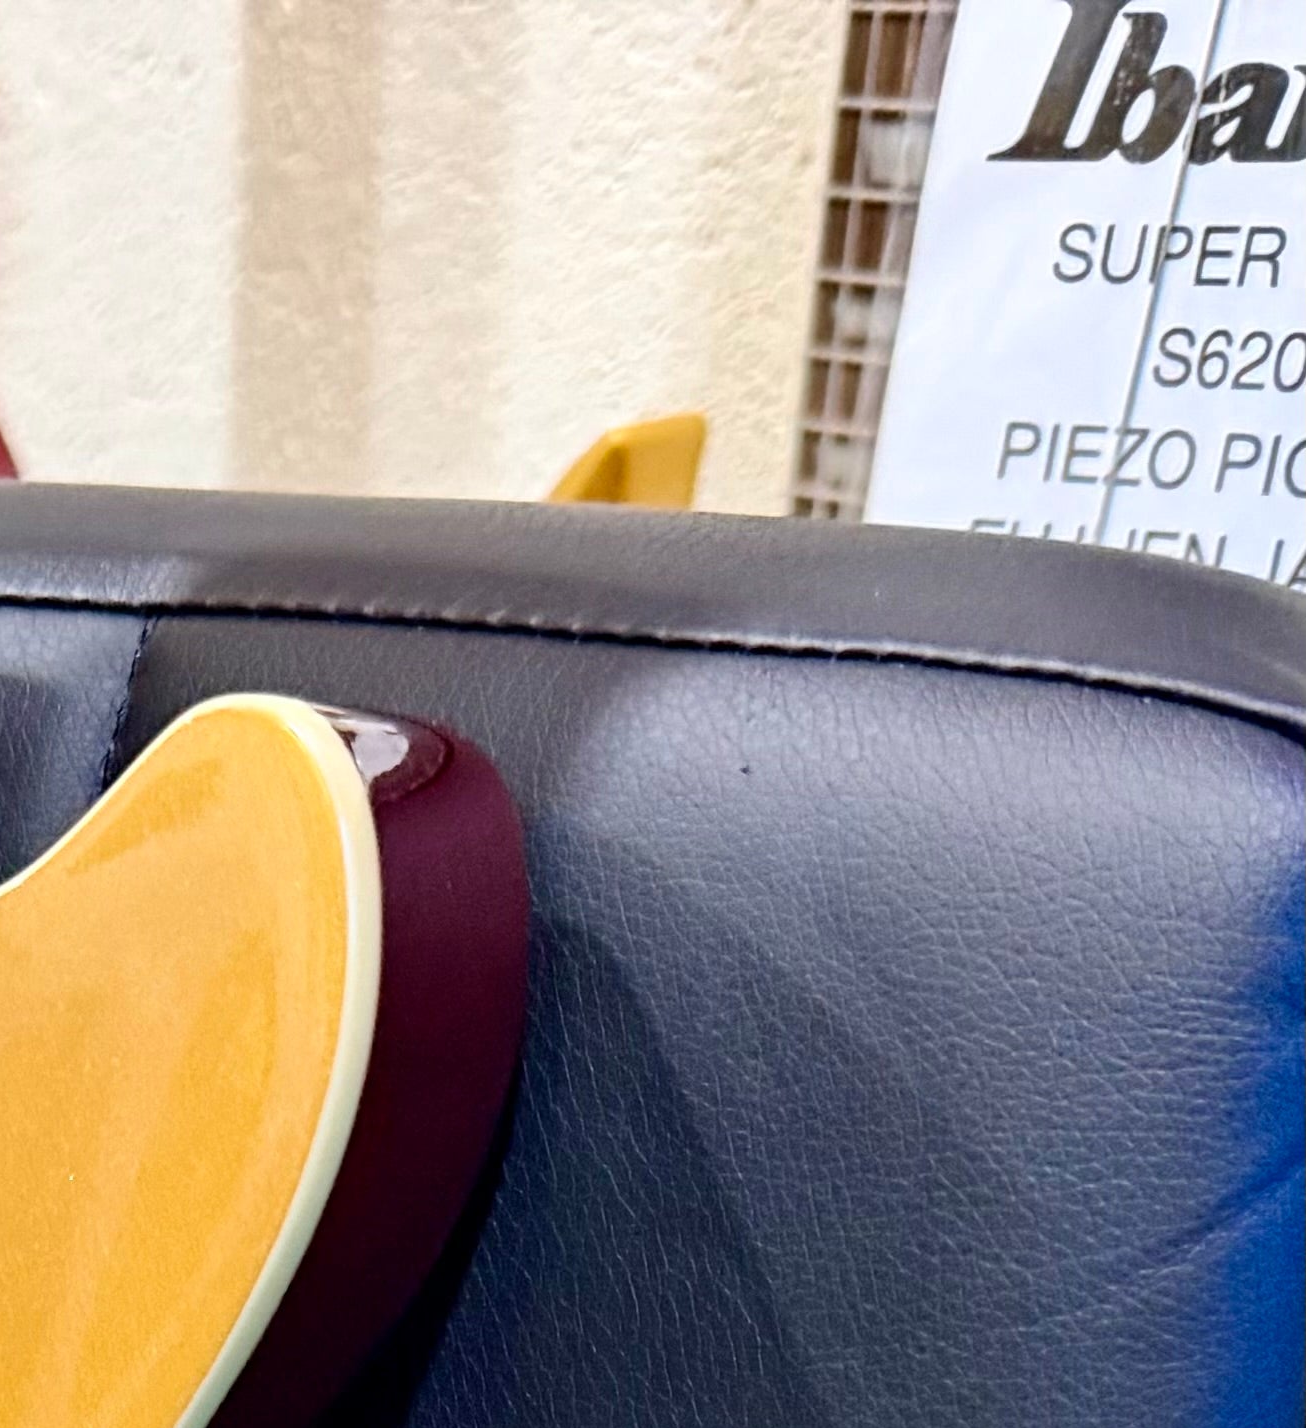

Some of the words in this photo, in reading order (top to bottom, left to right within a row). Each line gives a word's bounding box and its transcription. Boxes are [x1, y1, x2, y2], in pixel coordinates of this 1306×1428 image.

[986, 0, 1306, 165] Iba
[1052, 222, 1288, 288] SUPER
[997, 420, 1197, 490] PIEZO
